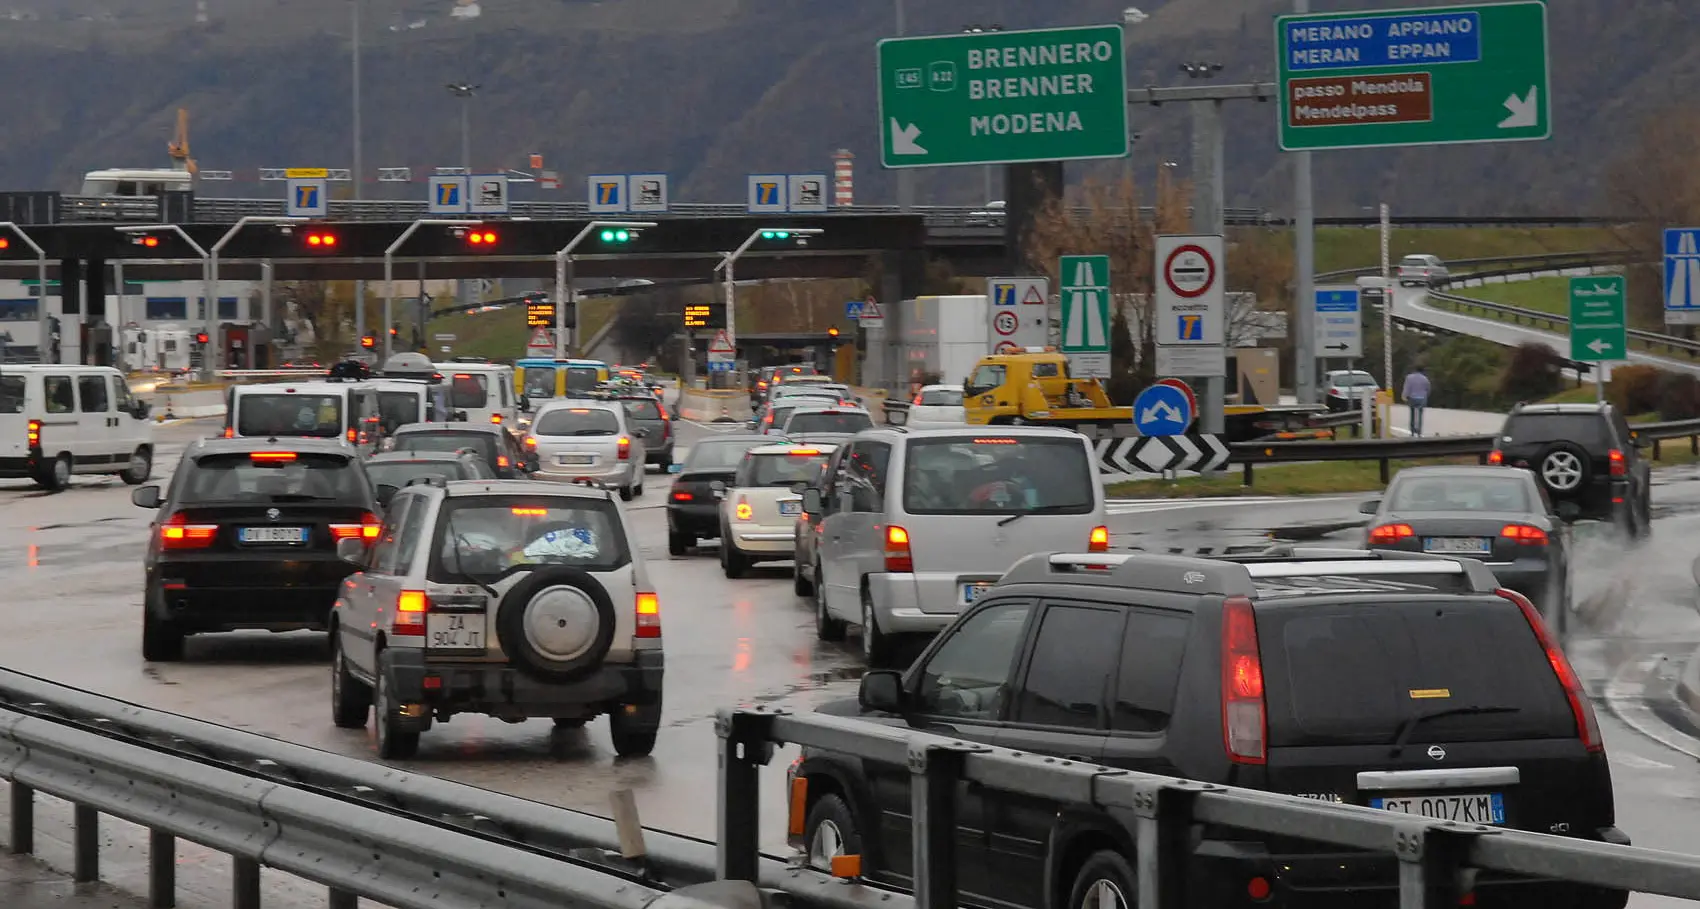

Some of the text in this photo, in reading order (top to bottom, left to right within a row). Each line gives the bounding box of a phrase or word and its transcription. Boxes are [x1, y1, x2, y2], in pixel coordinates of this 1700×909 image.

[1291, 18, 1473, 43] MERANO APPIANO
[967, 41, 1113, 69] BRENNERO
[1292, 42, 1451, 65] MERAN EPPAN
[968, 73, 1094, 100] BRENNER
[1293, 78, 1425, 100] passo Mendola
[970, 111, 1084, 136] MODENA
[1294, 102, 1397, 121] Mendelpass
[1000, 317, 1013, 329] 15
[448, 615, 465, 630] ZA
[1421, 796, 1490, 822] 007KM
